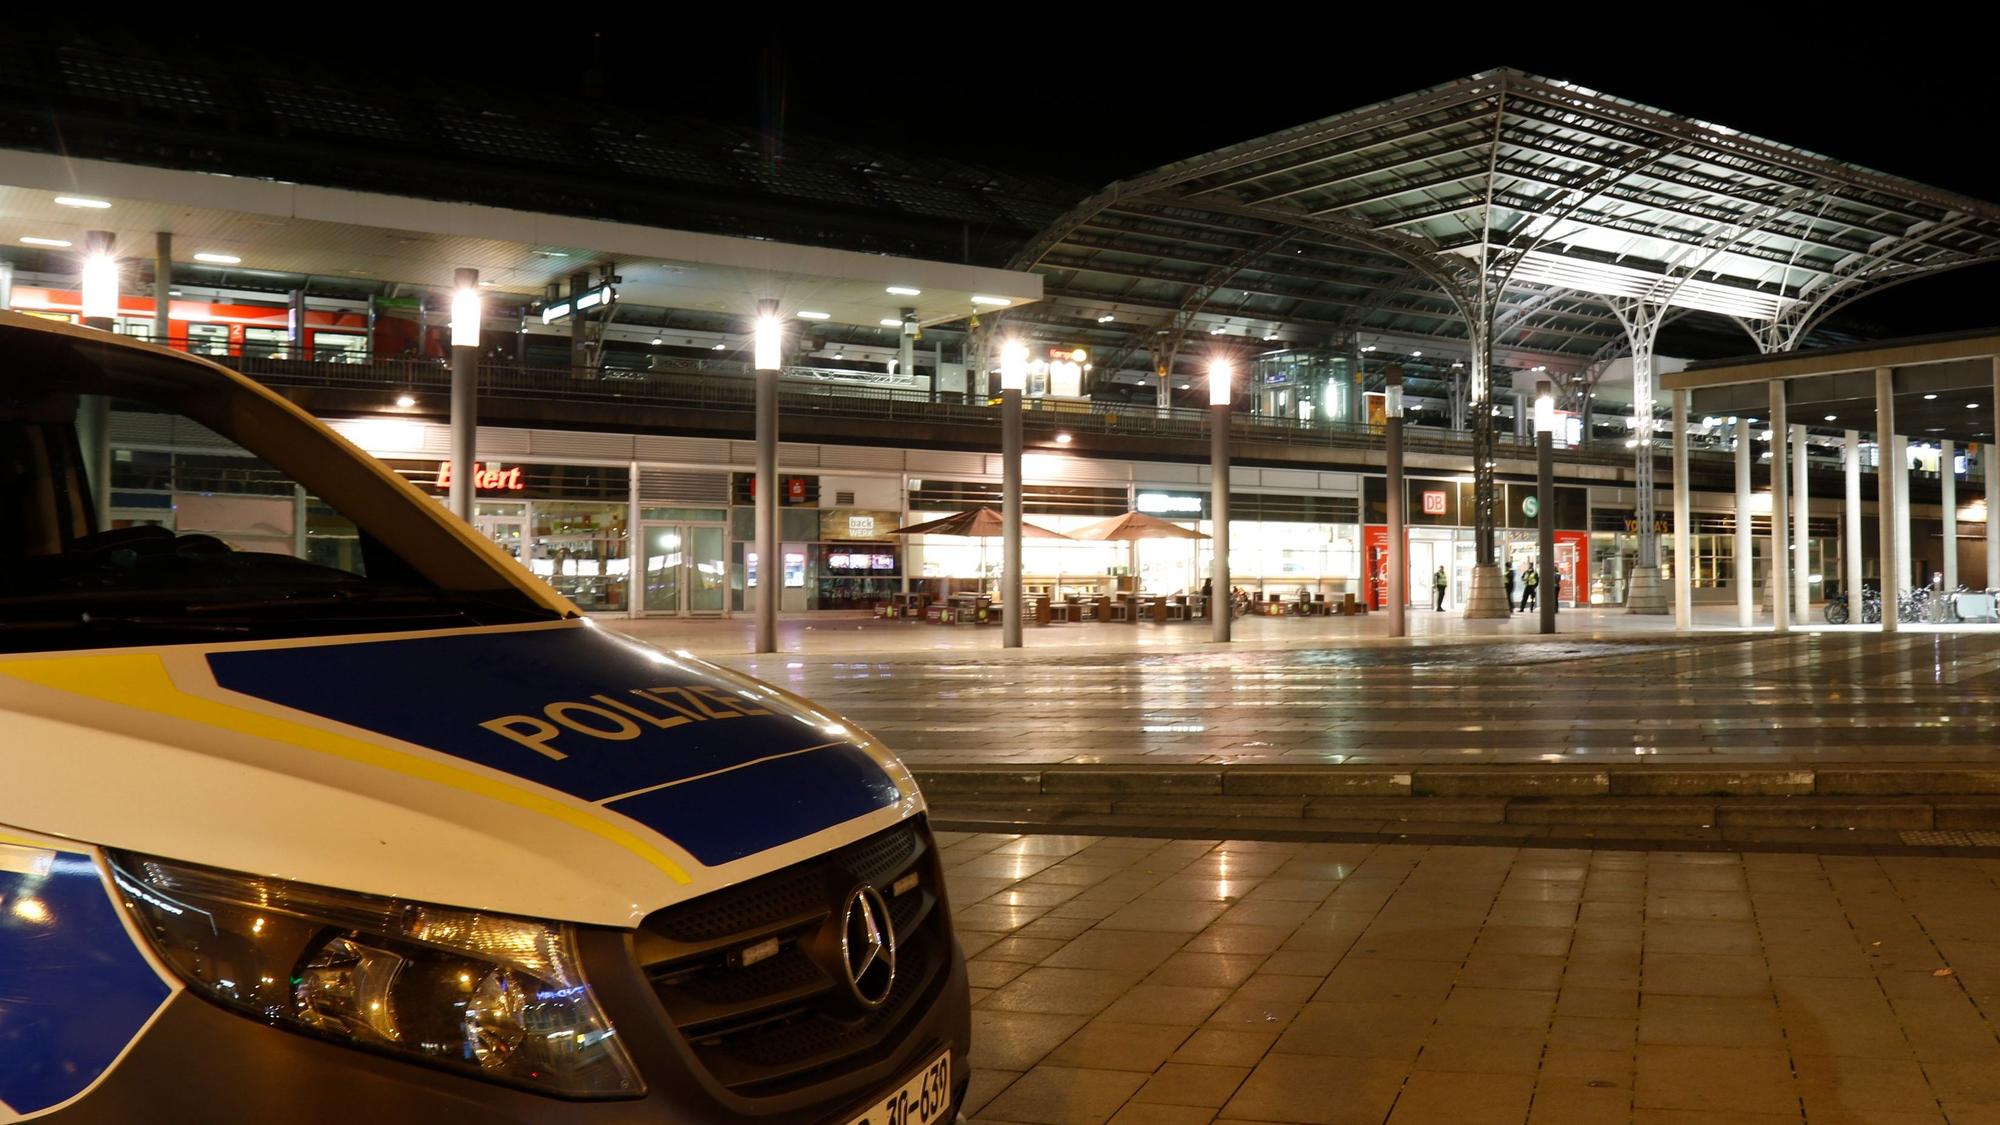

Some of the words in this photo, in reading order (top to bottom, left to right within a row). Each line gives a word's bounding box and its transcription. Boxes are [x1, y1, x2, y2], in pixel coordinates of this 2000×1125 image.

[232, 325, 242, 336] 2
[436, 462, 524, 489] Ekert.
[850, 518, 872, 528] back
[1624, 519, 1668, 533] YOA'S
[849, 529, 873, 537] WERK
